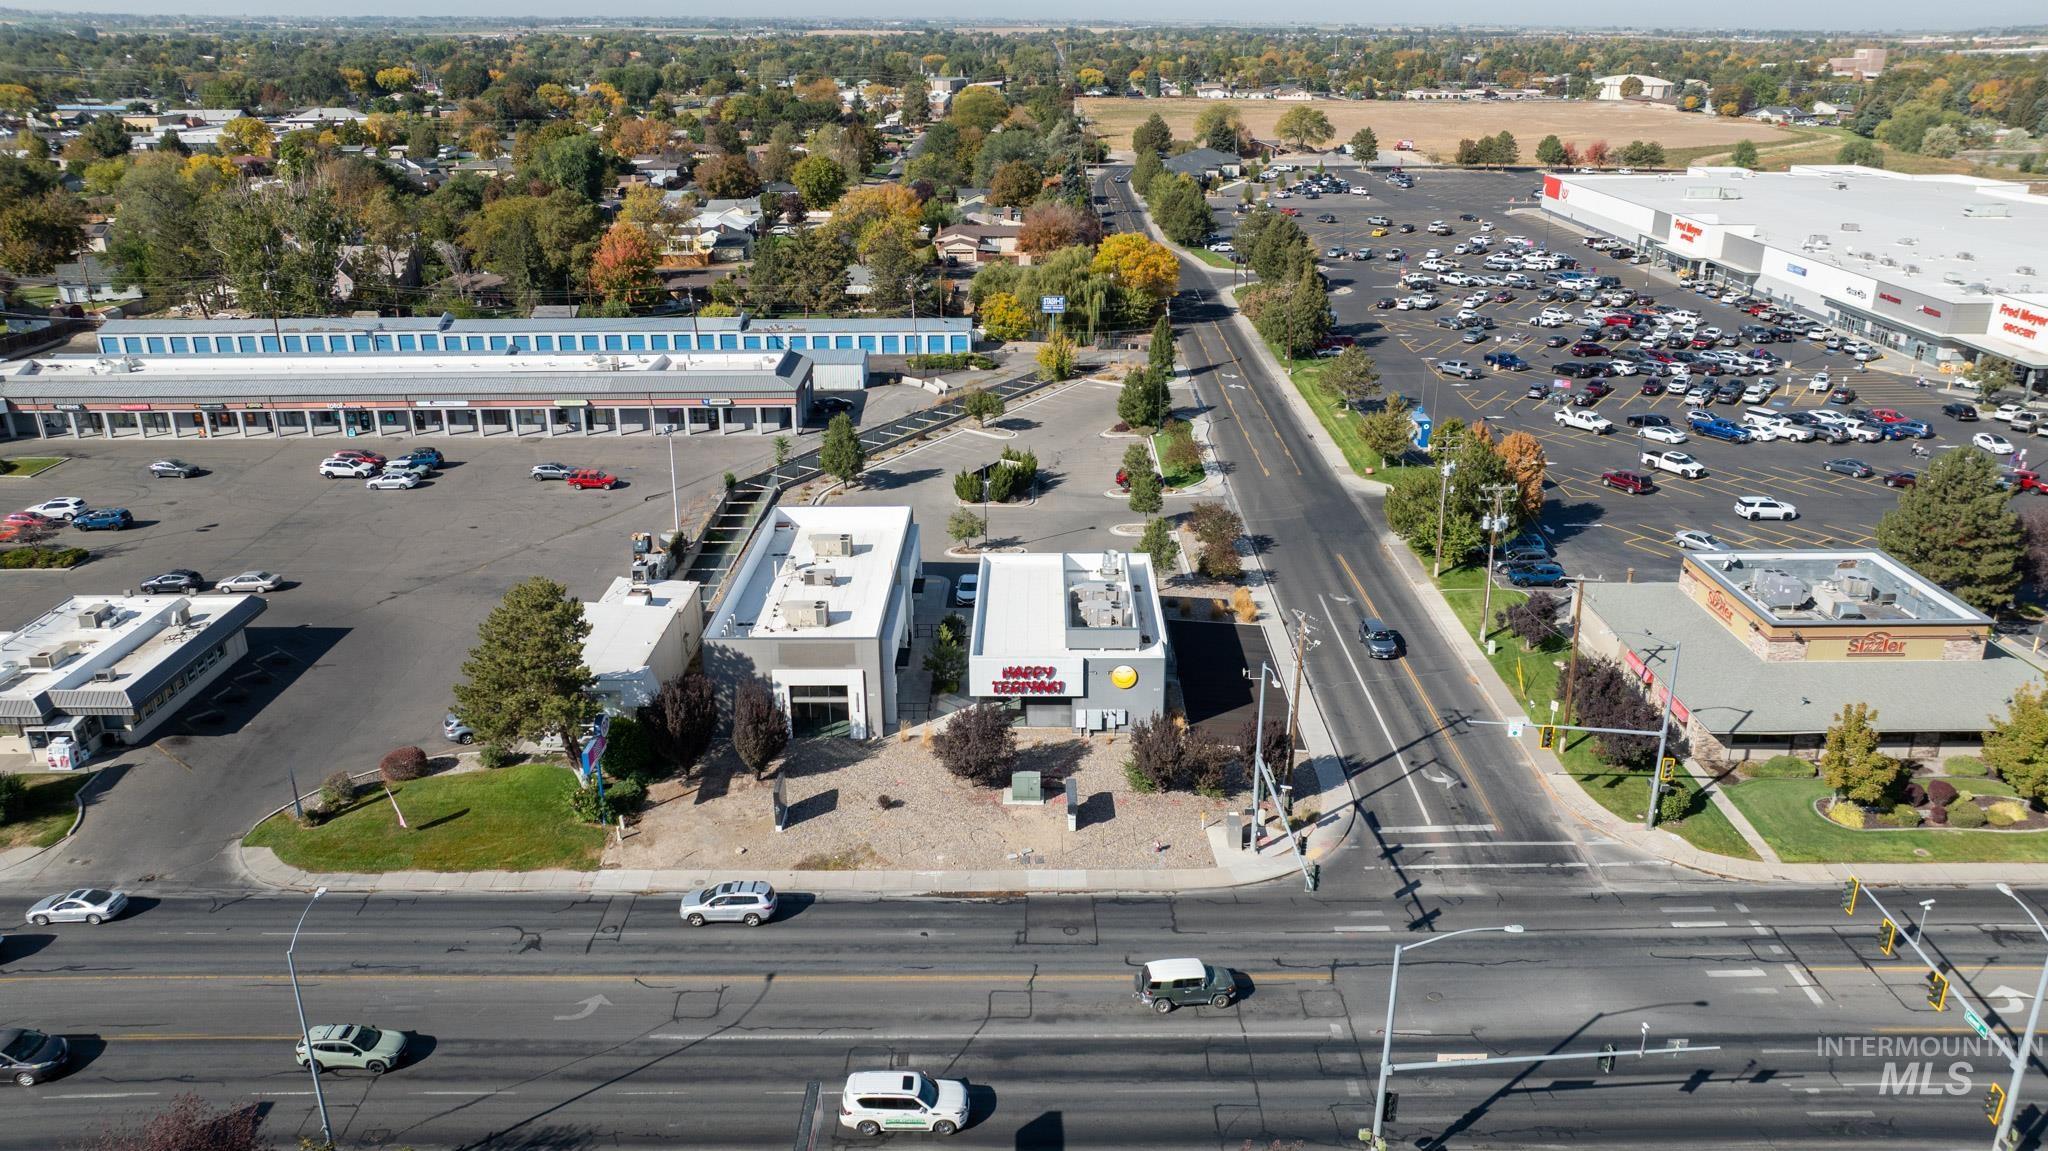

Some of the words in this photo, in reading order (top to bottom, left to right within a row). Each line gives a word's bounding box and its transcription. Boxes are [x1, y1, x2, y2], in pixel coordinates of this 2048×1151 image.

[1999, 303, 2020, 318] Fred
[2019, 309, 2048, 326] Meyer
[1707, 590, 1734, 620] Sizzler
[1848, 632, 1907, 652] Sizzler
[1002, 666, 1055, 679] HAPPY
[992, 680, 1065, 694] TERIYAKI
